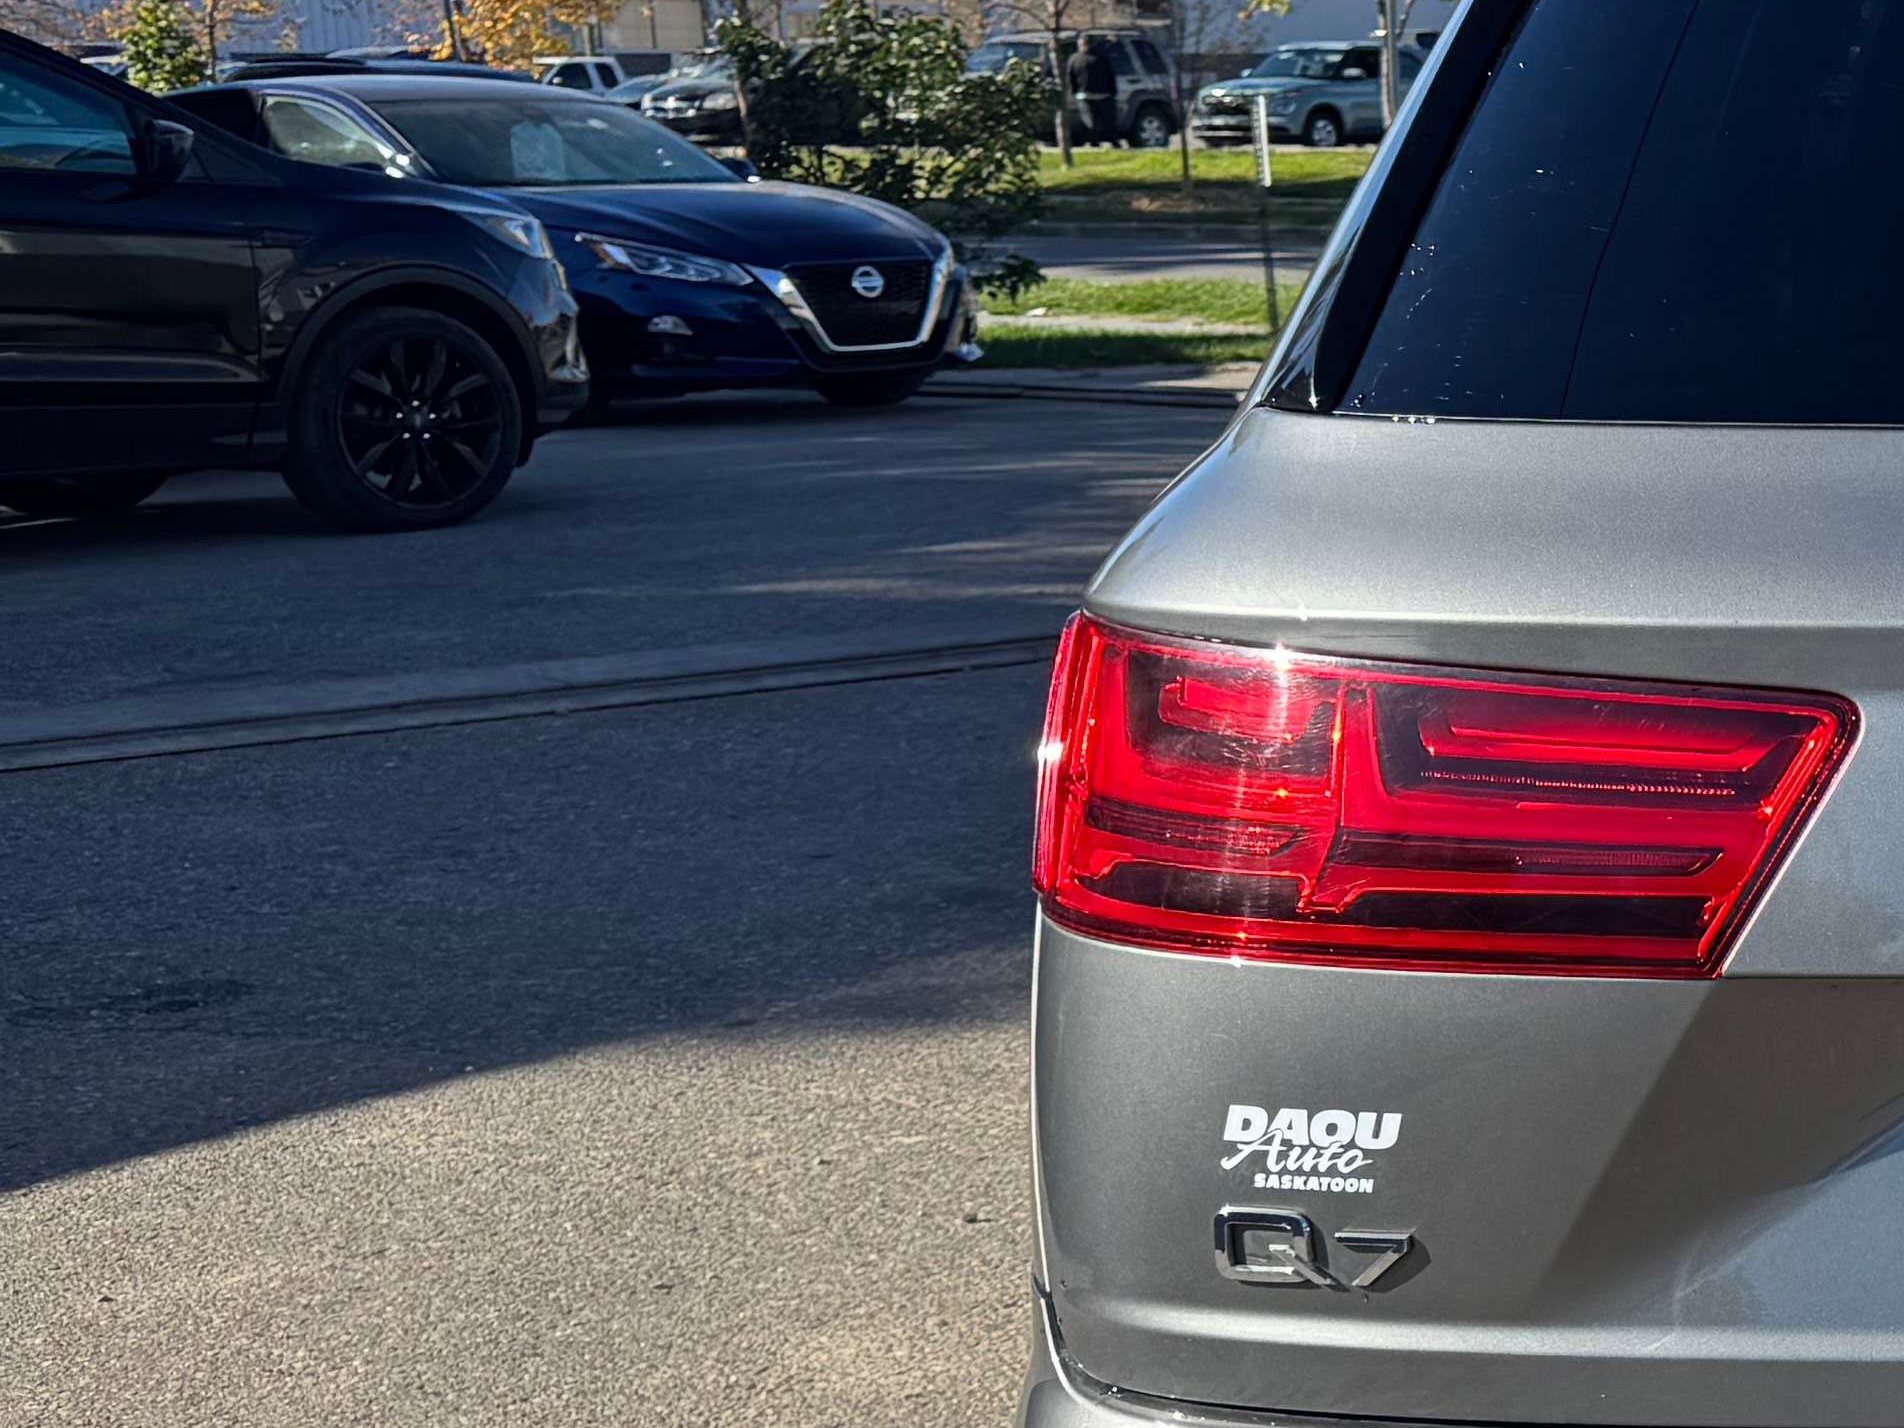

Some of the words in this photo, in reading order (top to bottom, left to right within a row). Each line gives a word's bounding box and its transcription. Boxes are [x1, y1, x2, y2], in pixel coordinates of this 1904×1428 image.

[1222, 1104, 1403, 1149] DAOU
[1220, 1129, 1374, 1173] Auto
[1253, 1173, 1374, 1193] SASKATOON
[1214, 1204, 1417, 1286] Q7
